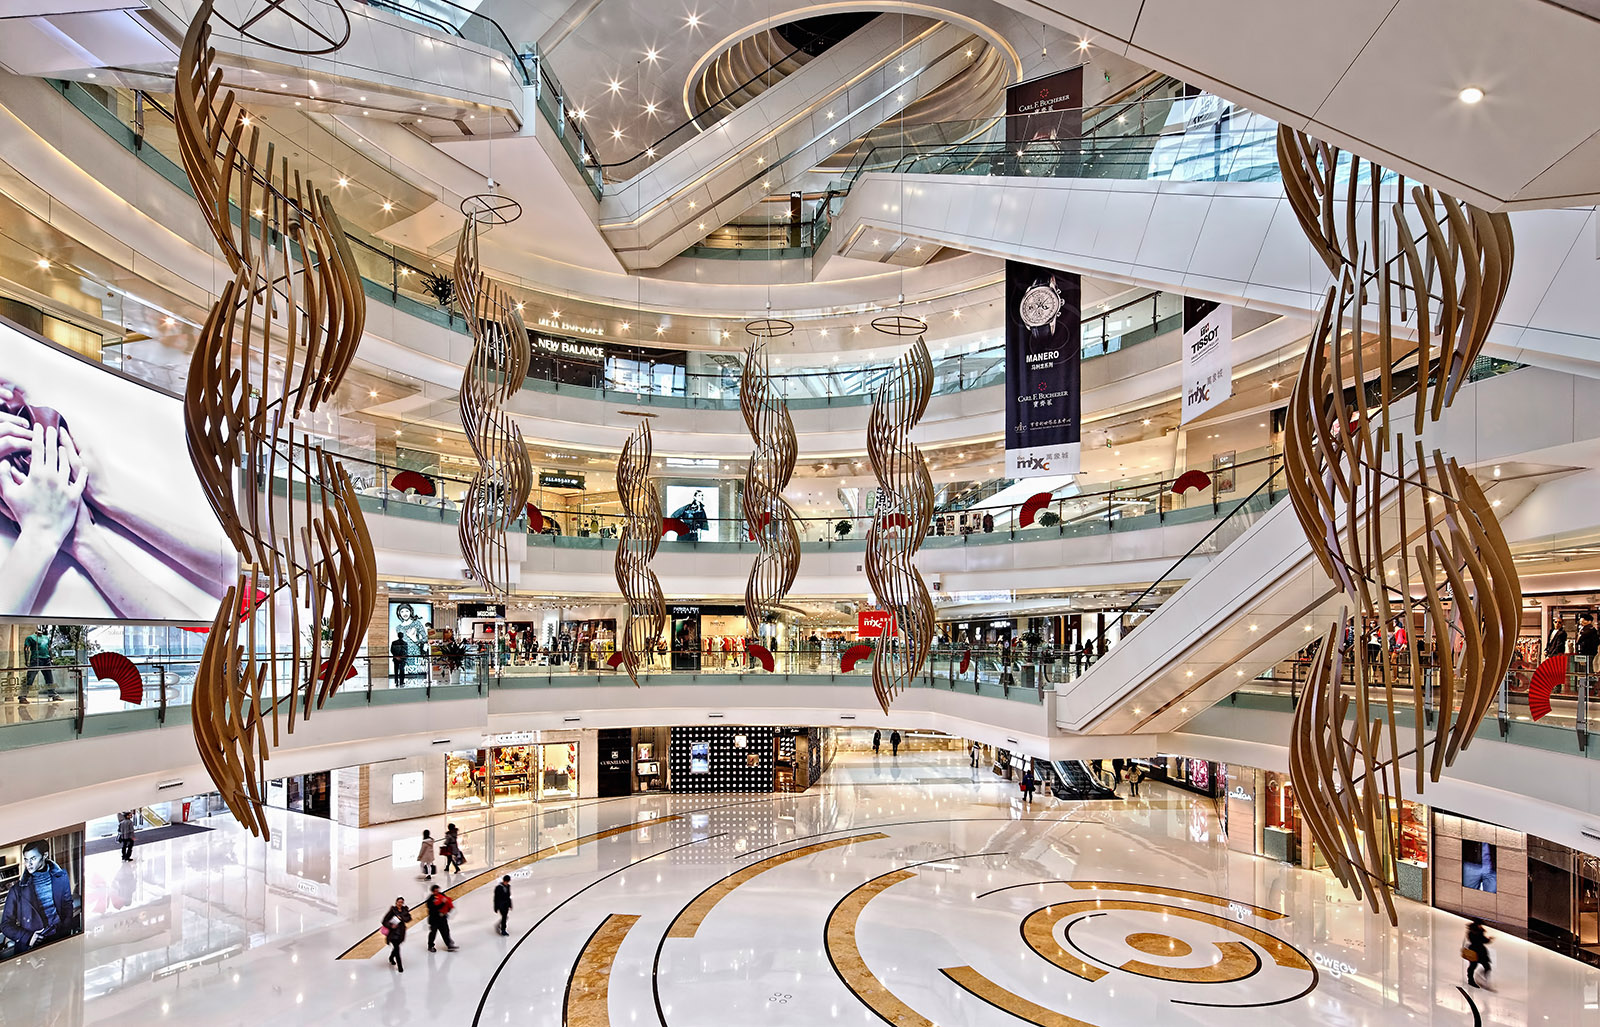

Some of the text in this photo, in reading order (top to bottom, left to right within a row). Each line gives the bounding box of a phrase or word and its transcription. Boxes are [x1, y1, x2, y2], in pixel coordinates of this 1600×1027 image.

[1018, 103, 1034, 113] CARL
[1040, 94, 1070, 106] BUCHERER
[538, 338, 605, 358] NEW BALANCE
[1190, 325, 1220, 354] TISSOT
[1025, 350, 1060, 363] MANERO
[1017, 395, 1033, 403] CARL
[1038, 391, 1069, 400] BUCHERER
